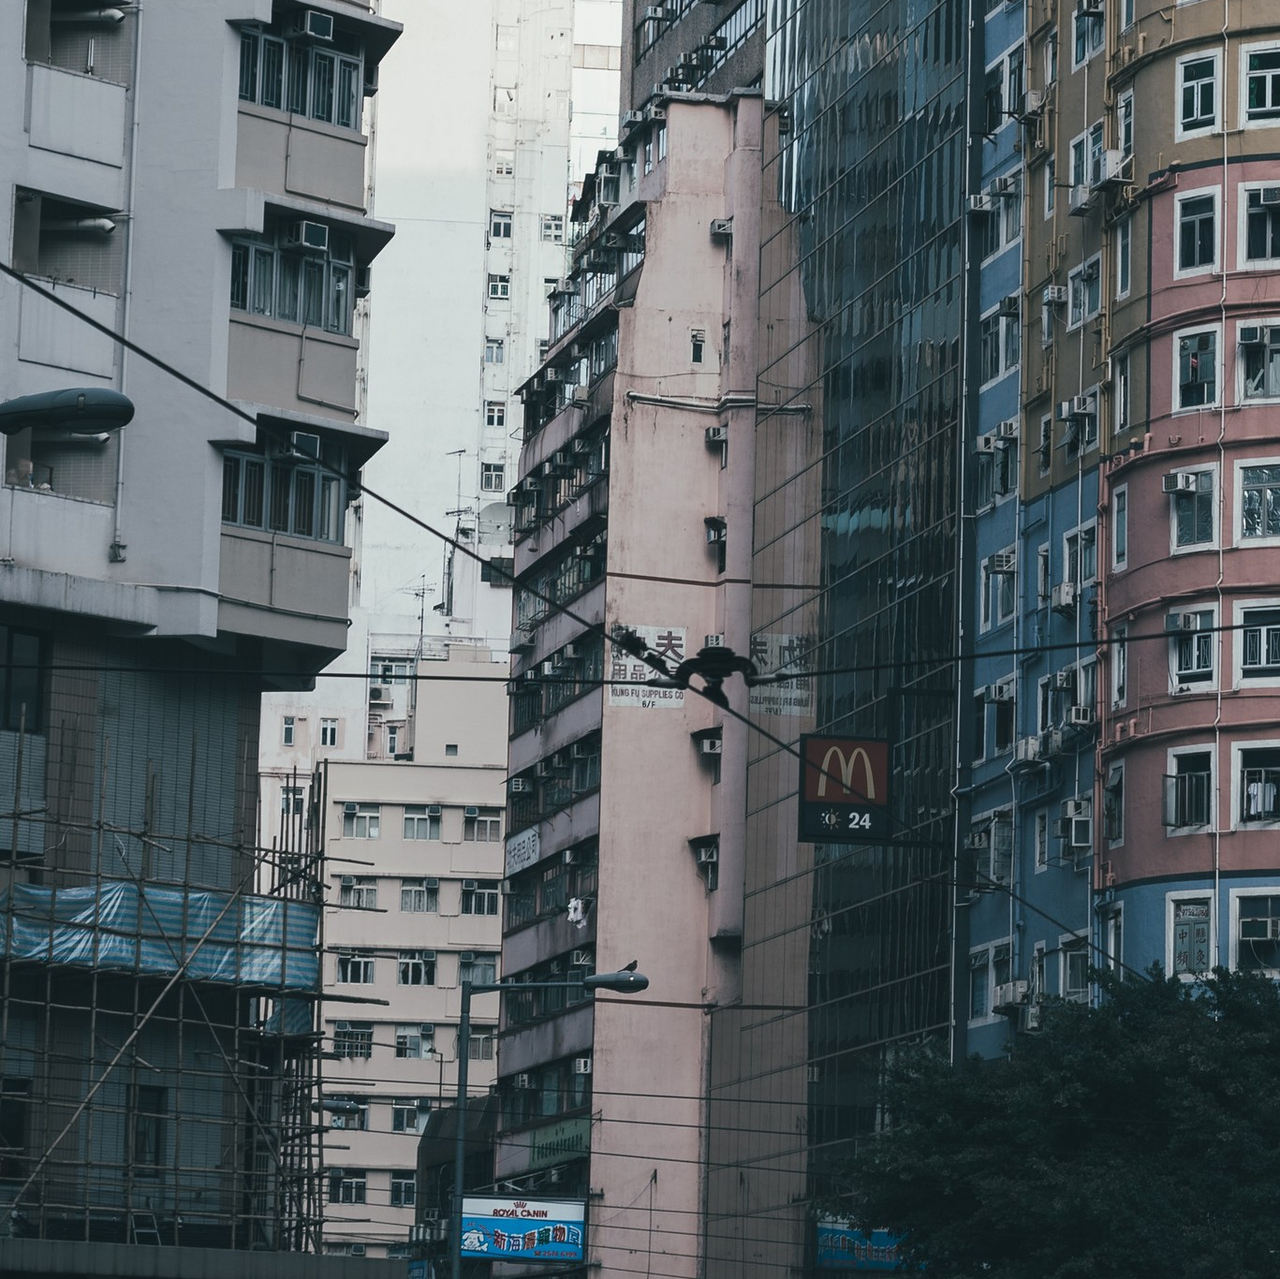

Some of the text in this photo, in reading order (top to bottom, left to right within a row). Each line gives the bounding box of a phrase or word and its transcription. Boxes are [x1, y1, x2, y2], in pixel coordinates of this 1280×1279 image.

[631, 689, 640, 697] FU
[641, 689, 673, 699] SUPPLIES
[848, 811, 872, 830] 24
[493, 1209, 547, 1218] ROYAL CANIN
